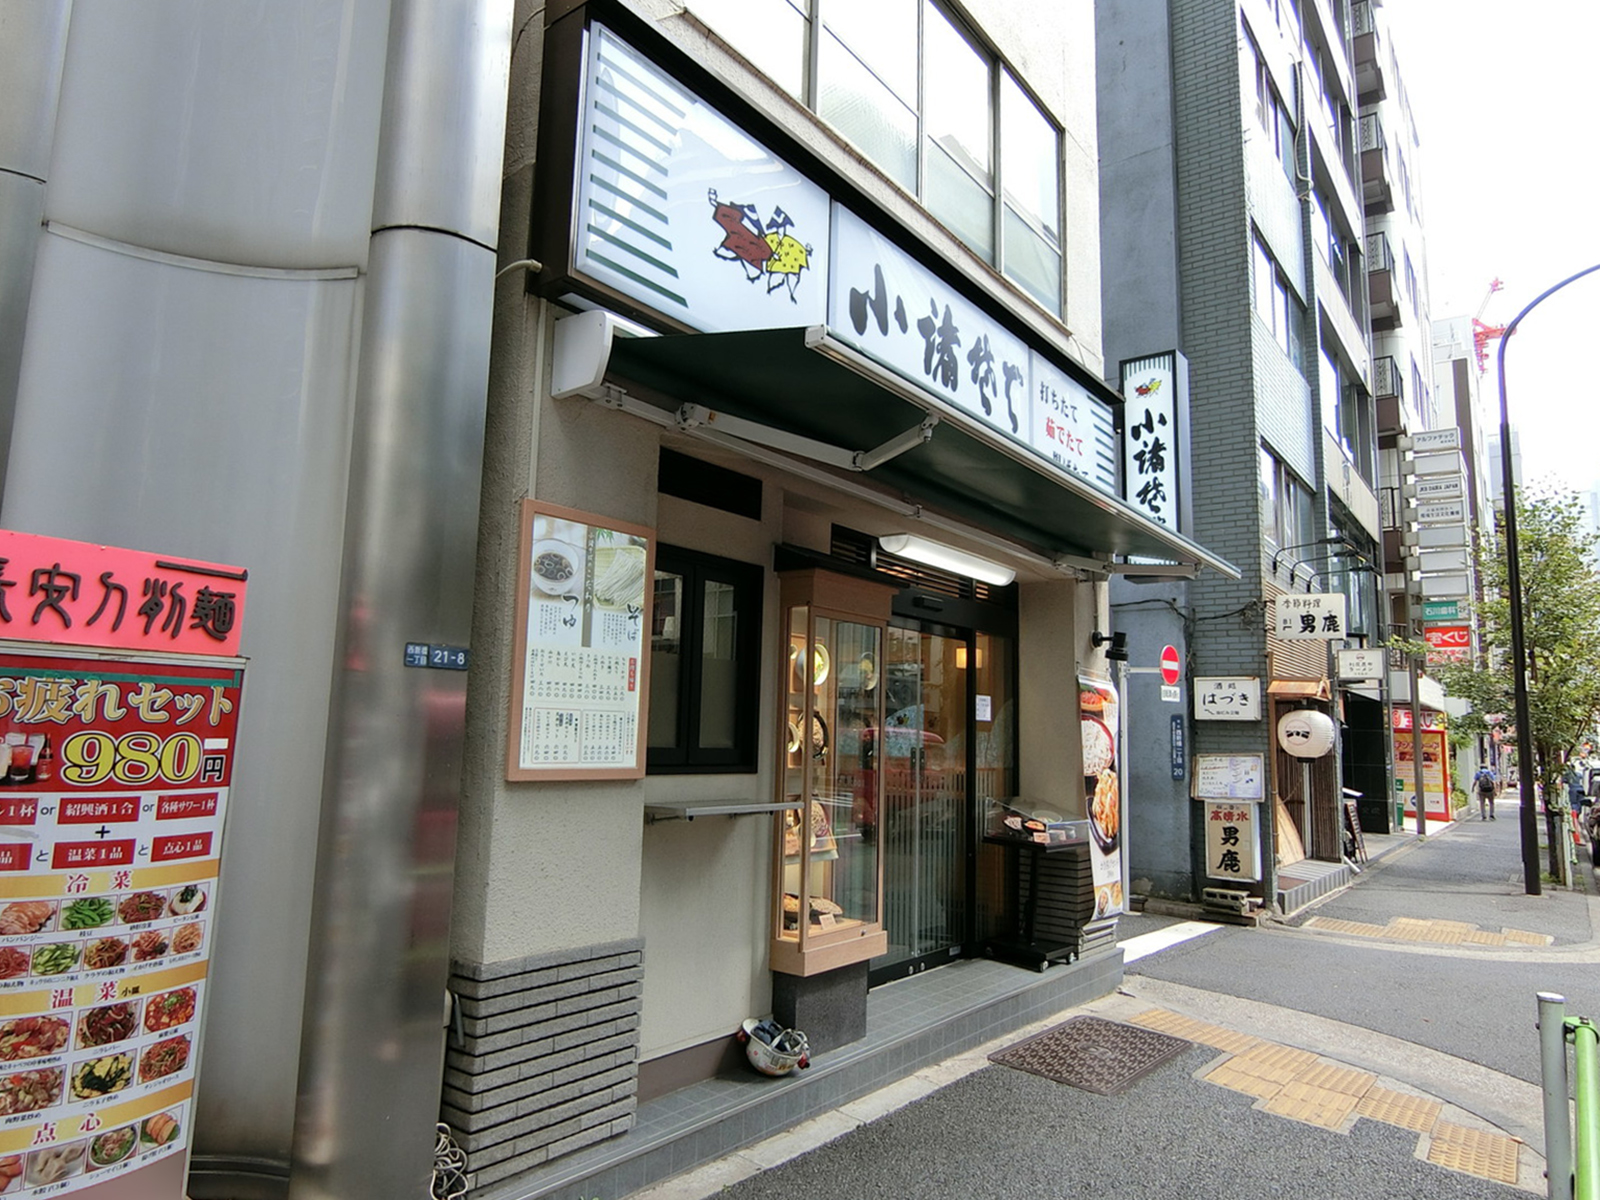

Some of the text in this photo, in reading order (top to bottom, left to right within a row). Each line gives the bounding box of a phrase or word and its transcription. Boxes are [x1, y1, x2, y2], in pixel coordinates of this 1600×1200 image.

[1039, 381, 1078, 423] 打ちたて
[1045, 416, 1084, 456] 茹でたて
[563, 594, 579, 630] つゆ
[1282, 598, 1322, 609] 季節料理
[627, 602, 643, 642] そば
[1298, 614, 1341, 634] 男鹿
[1426, 630, 1468, 644] 宝くじ
[433, 650, 465, 665] 21-8
[1202, 692, 1249, 706] はづき
[1173, 768, 1183, 776] 20
[40, 806, 56, 815] or
[142, 803, 155, 812] or
[1210, 809, 1250, 822] 高清水
[36, 849, 49, 861] と
[67, 846, 123, 862] 温菜1品
[138, 844, 149, 856] と
[162, 839, 203, 855] 点心1品
[1216, 826, 1241, 873] 男鹿
[64, 870, 133, 894] 冷菜
[51, 981, 141, 1009] 温菜 小皿
[32, 1113, 101, 1145] 点心
